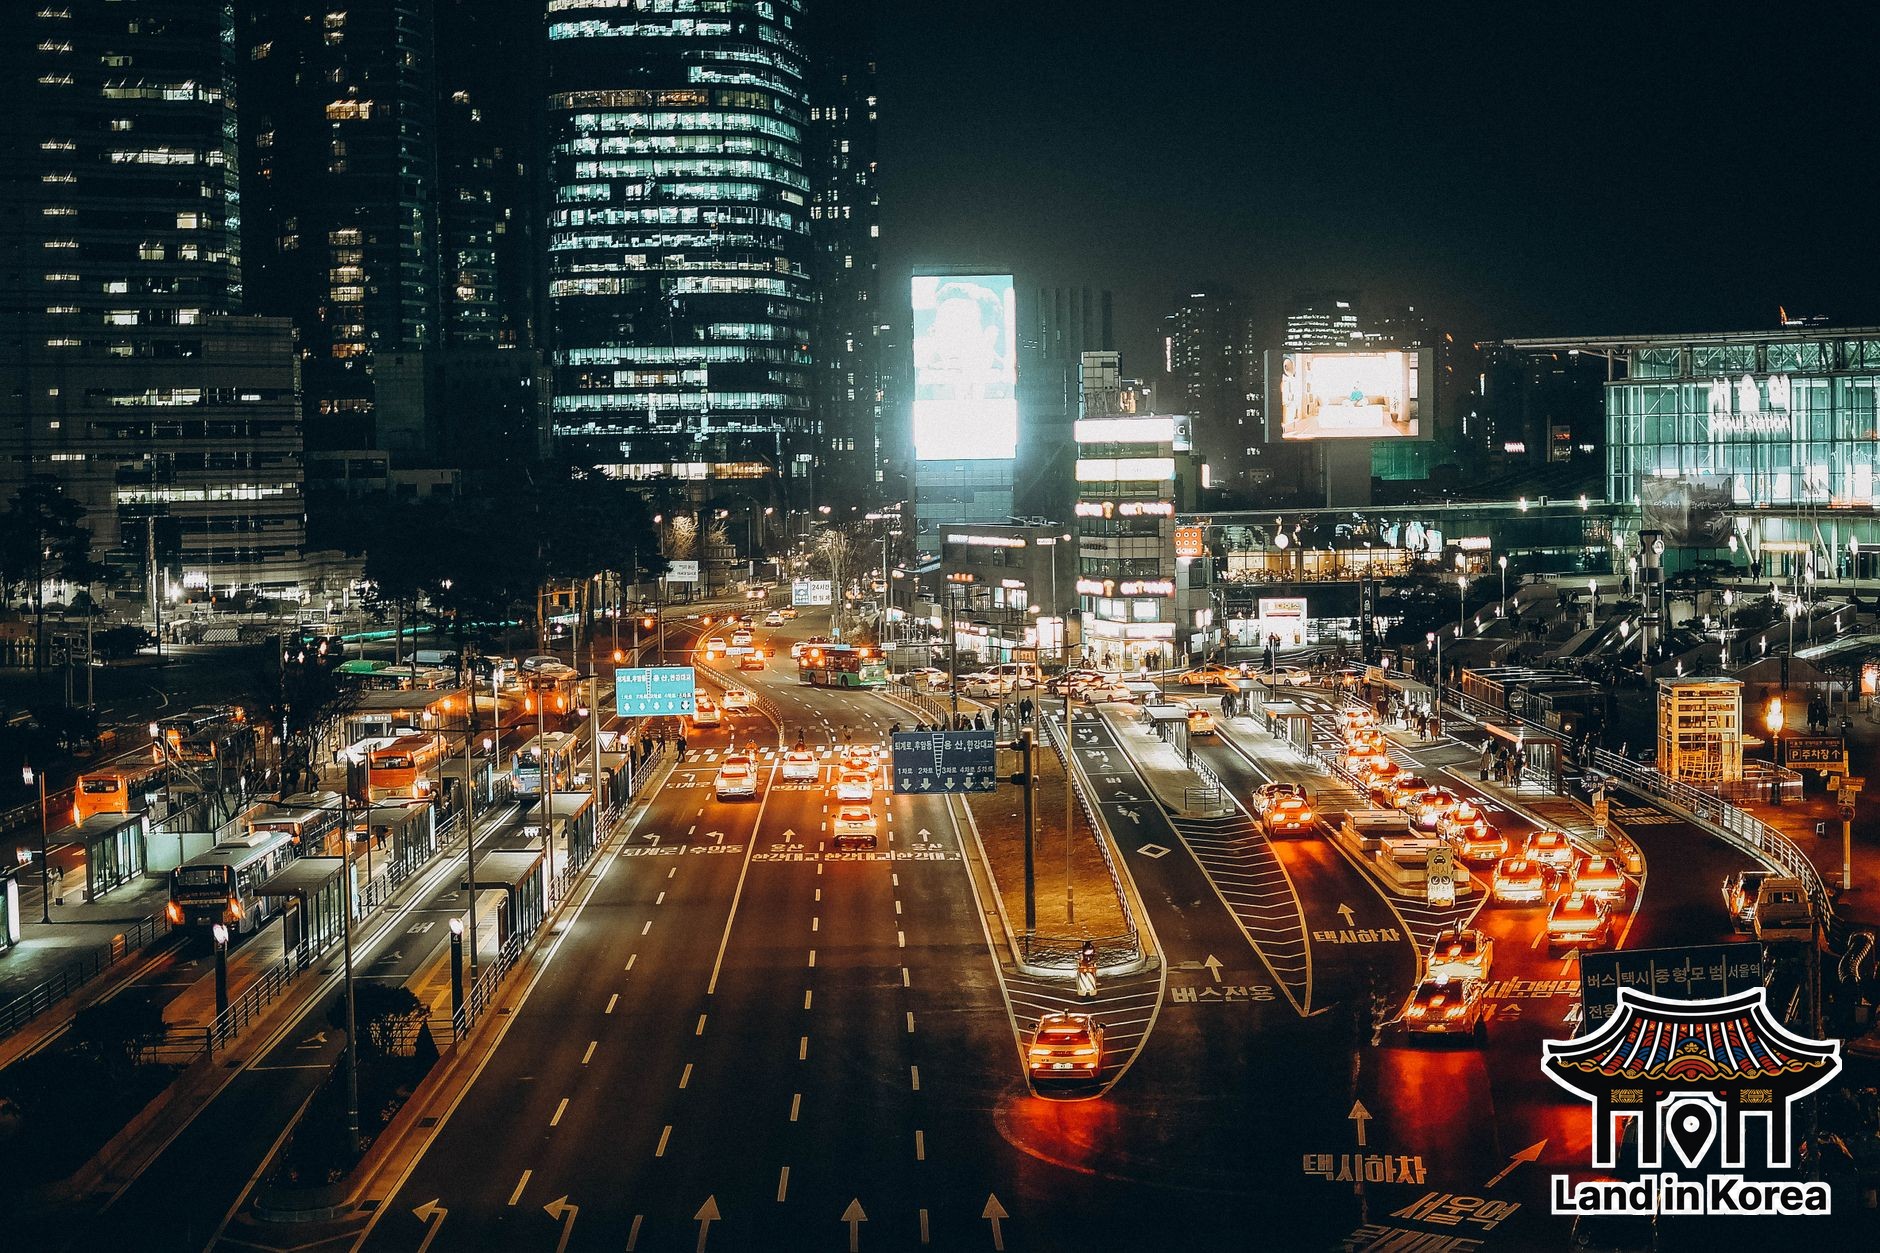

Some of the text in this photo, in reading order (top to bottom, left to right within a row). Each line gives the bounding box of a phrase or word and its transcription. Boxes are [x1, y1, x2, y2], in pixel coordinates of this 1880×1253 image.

[1363, 586, 1371, 625] 서울역
[1802, 749, 1829, 760] 주차장
[918, 767, 934, 775] 2차로
[622, 844, 744, 857] 퇴계로 후암동
[771, 843, 805, 852] 용산
[911, 843, 944, 852] 용산
[751, 851, 962, 862] 한강대교 한강대교 한강대교
[1312, 928, 1400, 944] 택시하차
[1586, 973, 1616, 988] 버스
[1620, 970, 1649, 986] 택시
[1727, 963, 1761, 979] 서울역
[1170, 985, 1277, 1003] 버스전용
[1302, 1154, 1428, 1185] 택시하차
[1389, 1191, 1523, 1231] 서울역
